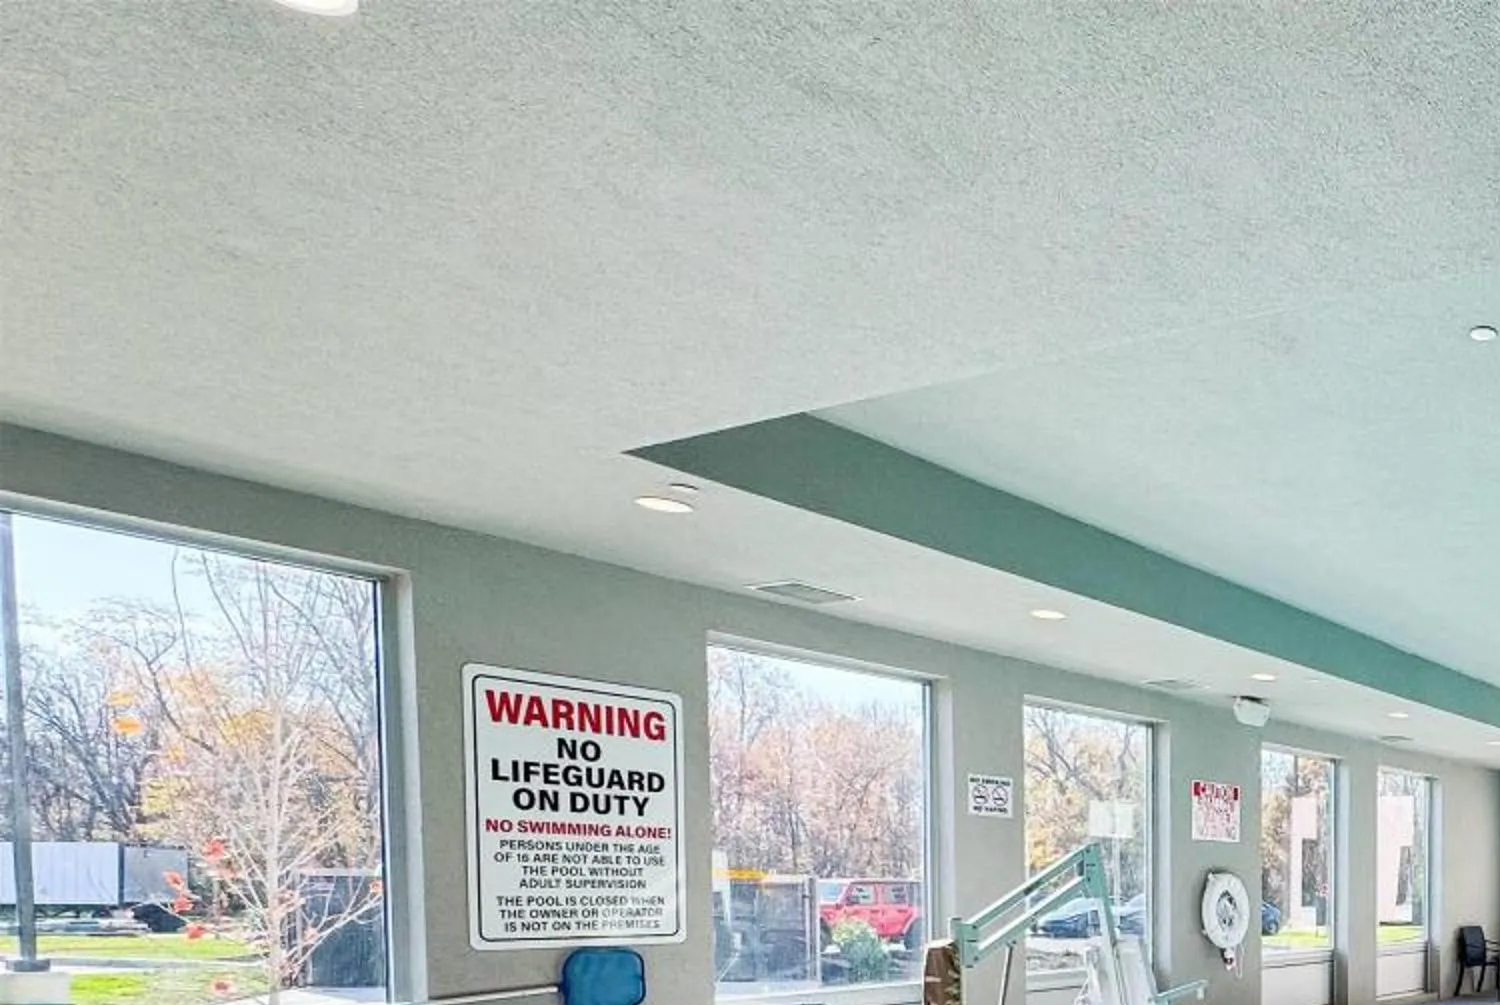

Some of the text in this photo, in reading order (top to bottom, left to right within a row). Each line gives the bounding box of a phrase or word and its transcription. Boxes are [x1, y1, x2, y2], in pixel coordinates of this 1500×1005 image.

[485, 689, 666, 741] WARNING
[557, 737, 601, 762] NO
[491, 758, 665, 793] LIFEGUARD
[512, 788, 649, 816] ON DUTY
[485, 818, 671, 839] NO SWIMMING ALONE!
[500, 840, 661, 854] PERSONS UNDER THE AGE
[494, 852, 665, 866] OF 16 ARE NOT ABLE TO USE
[522, 865, 643, 877] THE POOL WITHOUT
[519, 878, 647, 889] ADULT SUPERVISION
[496, 895, 523, 906] THE
[526, 896, 562, 906] POOL
[565, 896, 577, 906] IS
[580, 896, 628, 906] CLOSED
[500, 907, 663, 919] THE OWNER OR OPERATOR
[504, 921, 517, 932] IS
[521, 921, 548, 932] NOT
[551, 921, 571, 931] ON
[574, 920, 599, 930] THE
